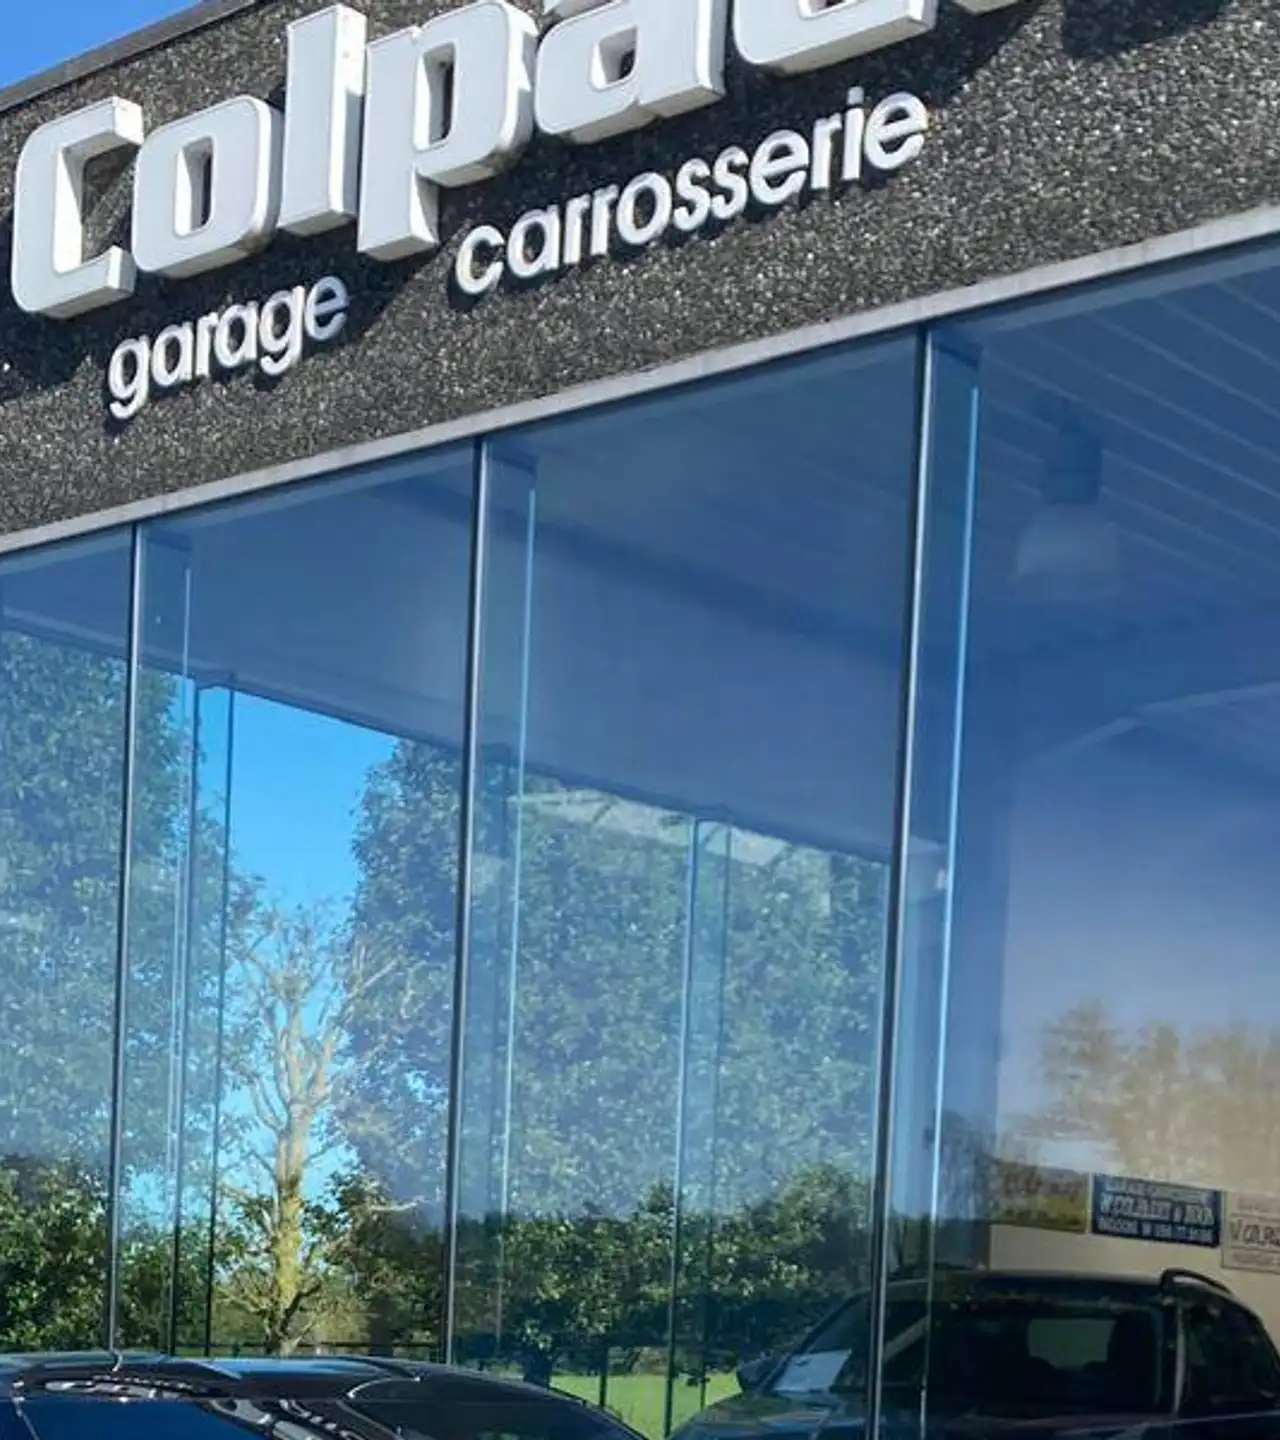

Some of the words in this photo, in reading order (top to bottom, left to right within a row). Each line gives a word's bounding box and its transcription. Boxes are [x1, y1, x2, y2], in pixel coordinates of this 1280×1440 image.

[10, 0, 1026, 319] Colpa
[107, 275, 349, 420] garage
[455, 86, 929, 296] carrosserie
